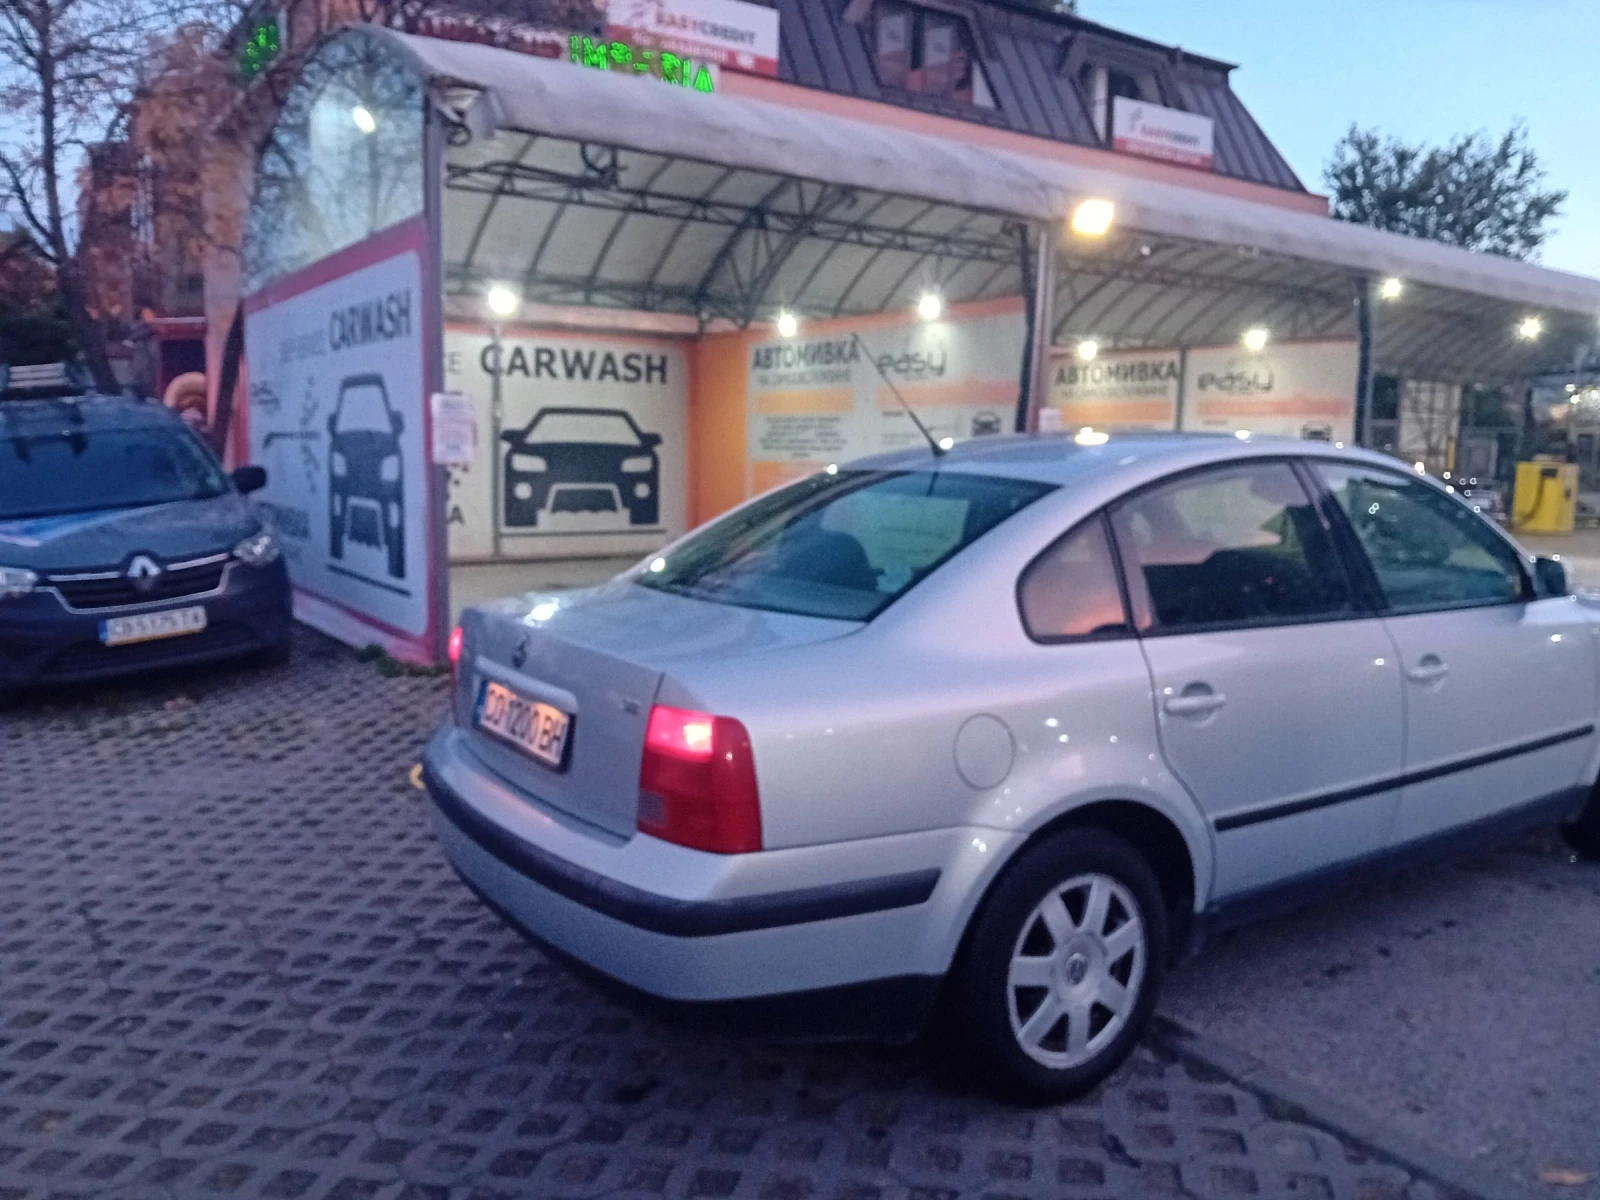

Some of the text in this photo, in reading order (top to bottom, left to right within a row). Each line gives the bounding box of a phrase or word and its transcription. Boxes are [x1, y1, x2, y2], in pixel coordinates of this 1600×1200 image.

[329, 287, 412, 352] CARWASH
[479, 343, 668, 386] CARWASH
[1055, 361, 1180, 386] АВТОМИВКА
